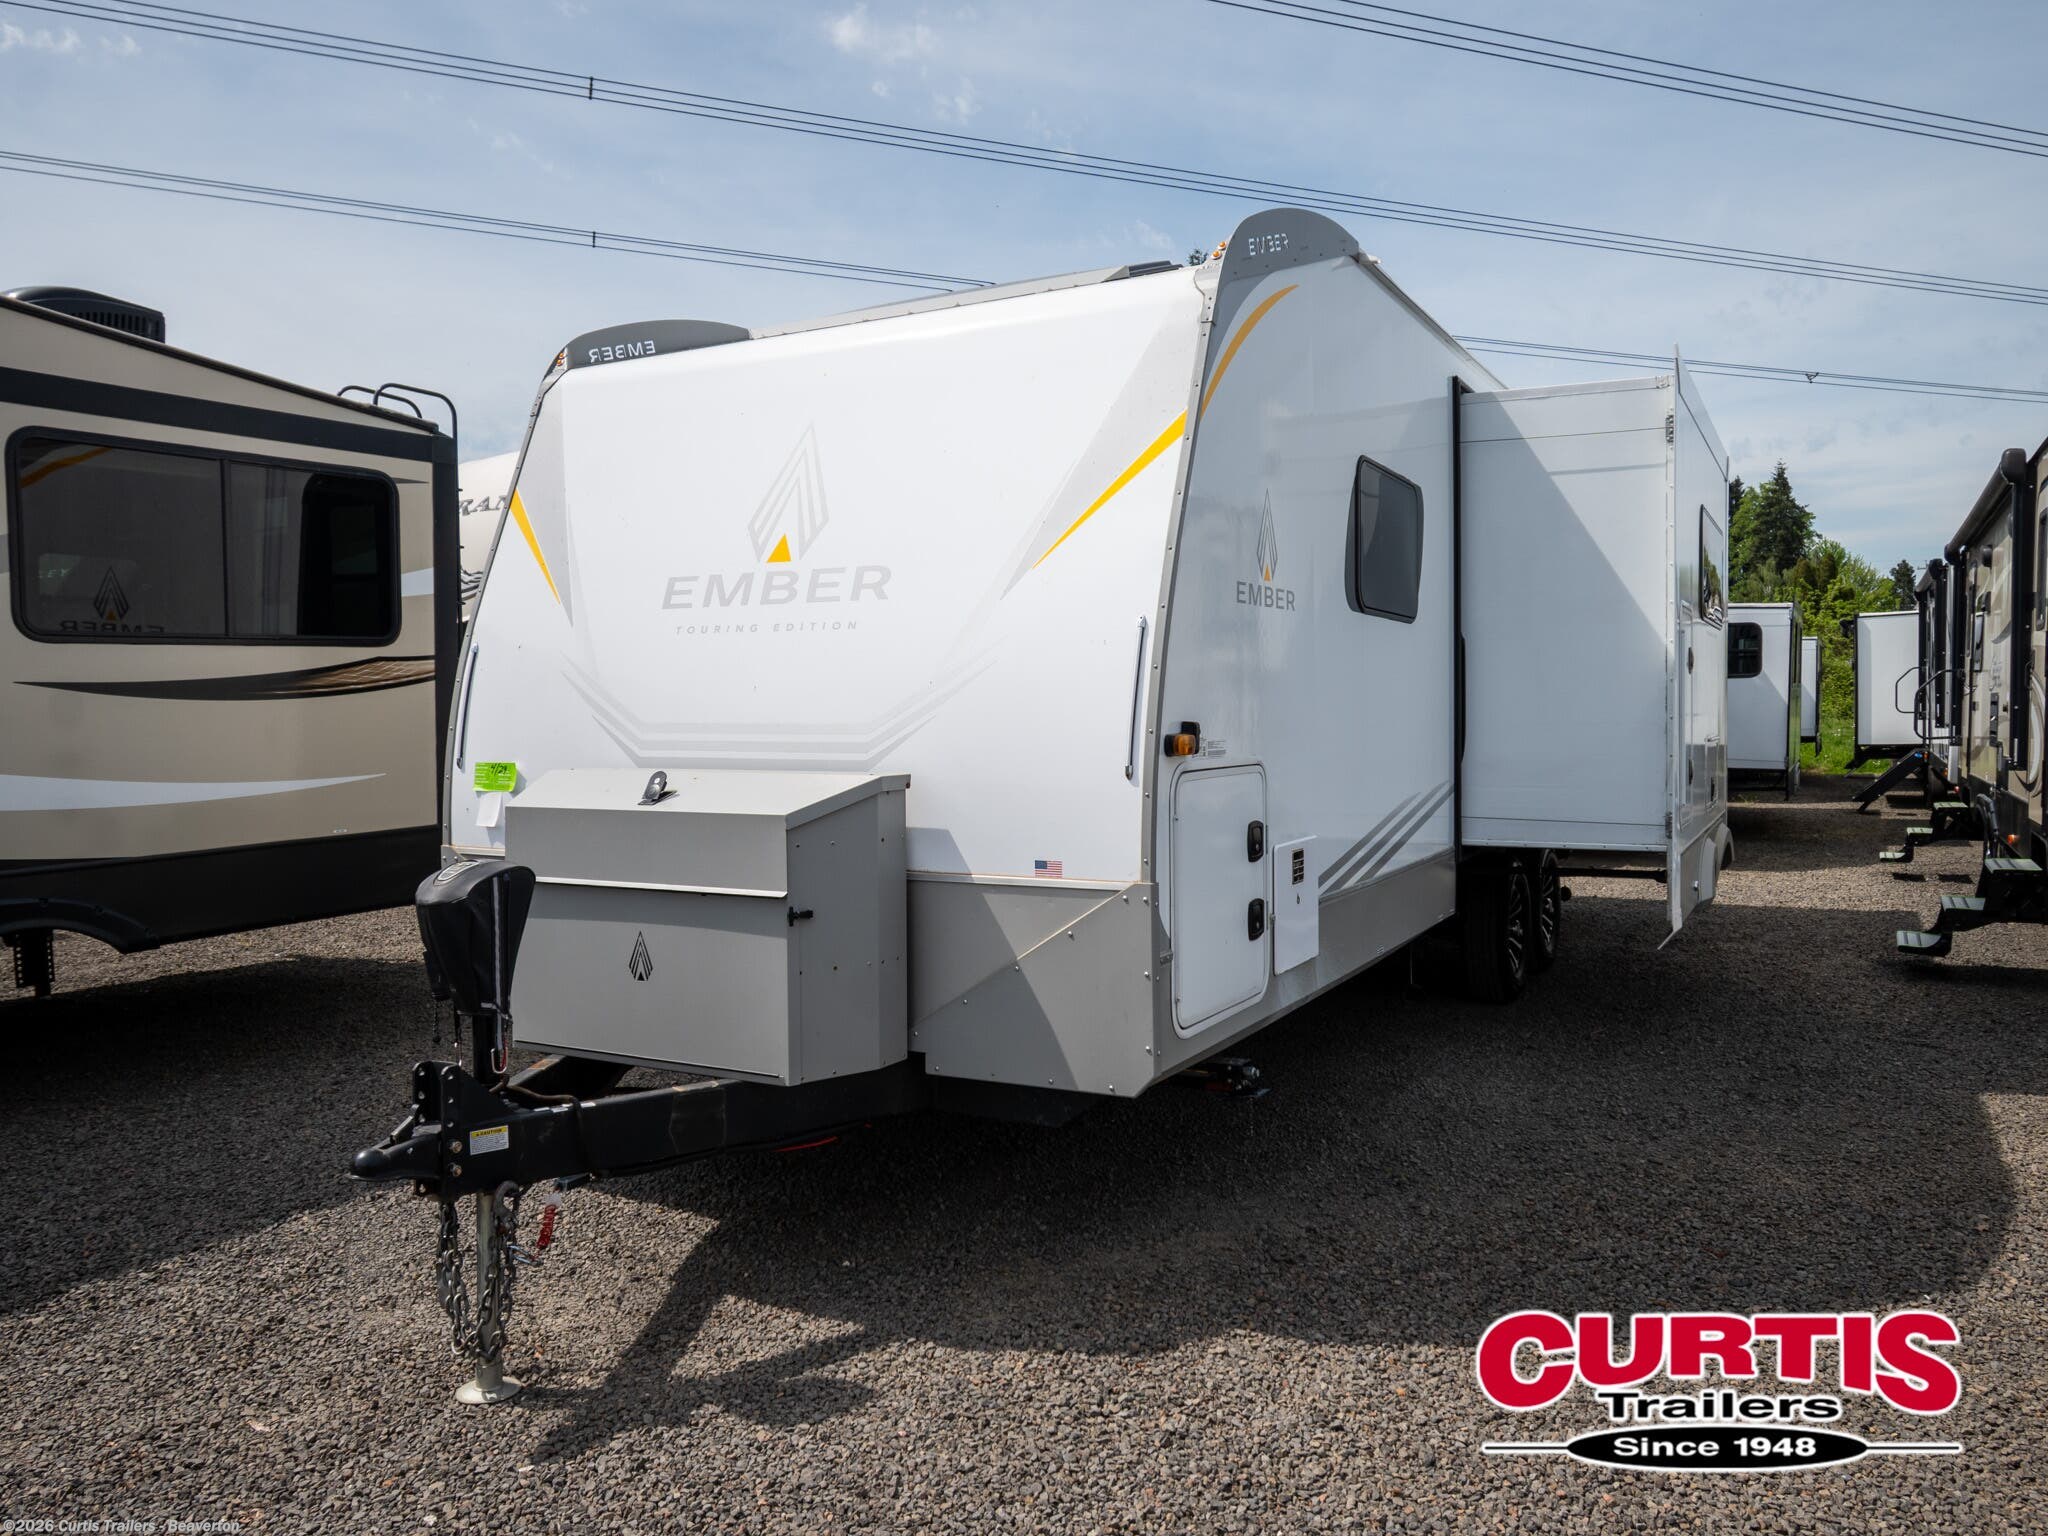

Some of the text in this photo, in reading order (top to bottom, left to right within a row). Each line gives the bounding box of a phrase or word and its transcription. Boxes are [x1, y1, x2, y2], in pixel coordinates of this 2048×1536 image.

[1248, 233, 1289, 256] EMBER
[662, 565, 892, 610] EMBER
[1236, 580, 1295, 611] EMBER
[676, 621, 857, 636] TOURING EDITION
